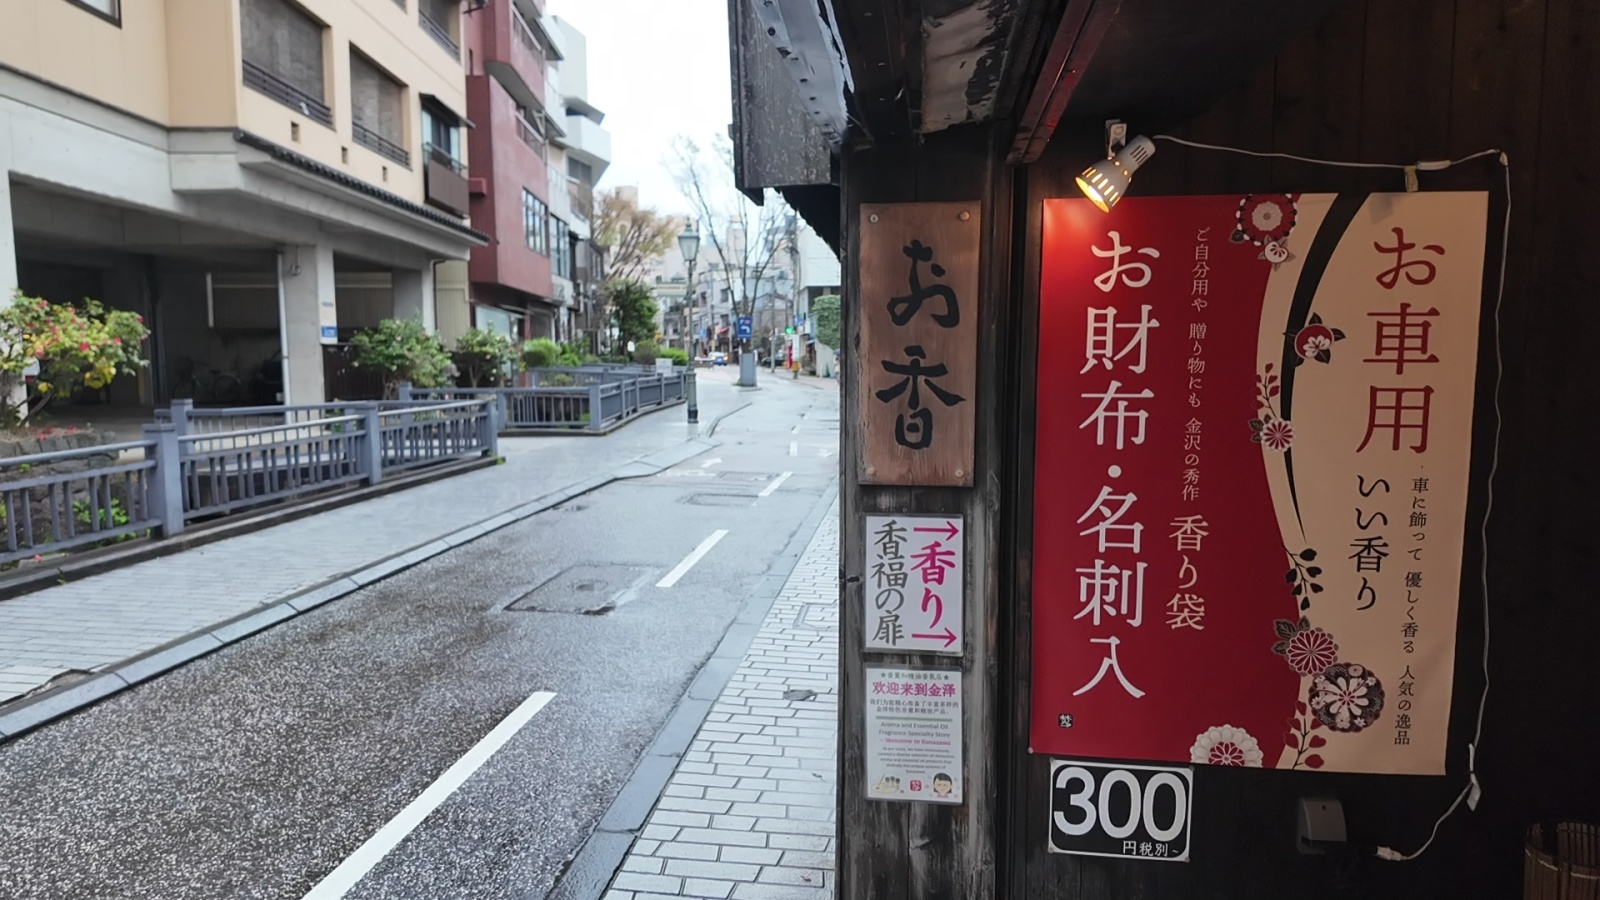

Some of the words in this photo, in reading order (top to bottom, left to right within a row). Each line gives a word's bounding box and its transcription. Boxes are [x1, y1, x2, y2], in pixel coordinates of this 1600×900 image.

[1190, 227, 1210, 312] ご自分用や
[875, 239, 967, 451] お香
[1187, 323, 1207, 408] 贈り物にも
[1356, 227, 1446, 454] お車用
[1072, 230, 1161, 699] お財布・名刺入
[1182, 417, 1203, 502] 金沢の秀作
[1348, 474, 1391, 612] いい香り
[1407, 476, 1430, 562] 車に飾って
[870, 519, 909, 647] 香福の扉
[910, 540, 956, 630] 香り
[1165, 514, 1210, 631] 香り袋
[1400, 571, 1423, 655] 優しく香る
[872, 681, 956, 697] 欢迎来到金泽
[1394, 664, 1416, 746] 人気の逸品
[1053, 766, 1187, 842] 300
